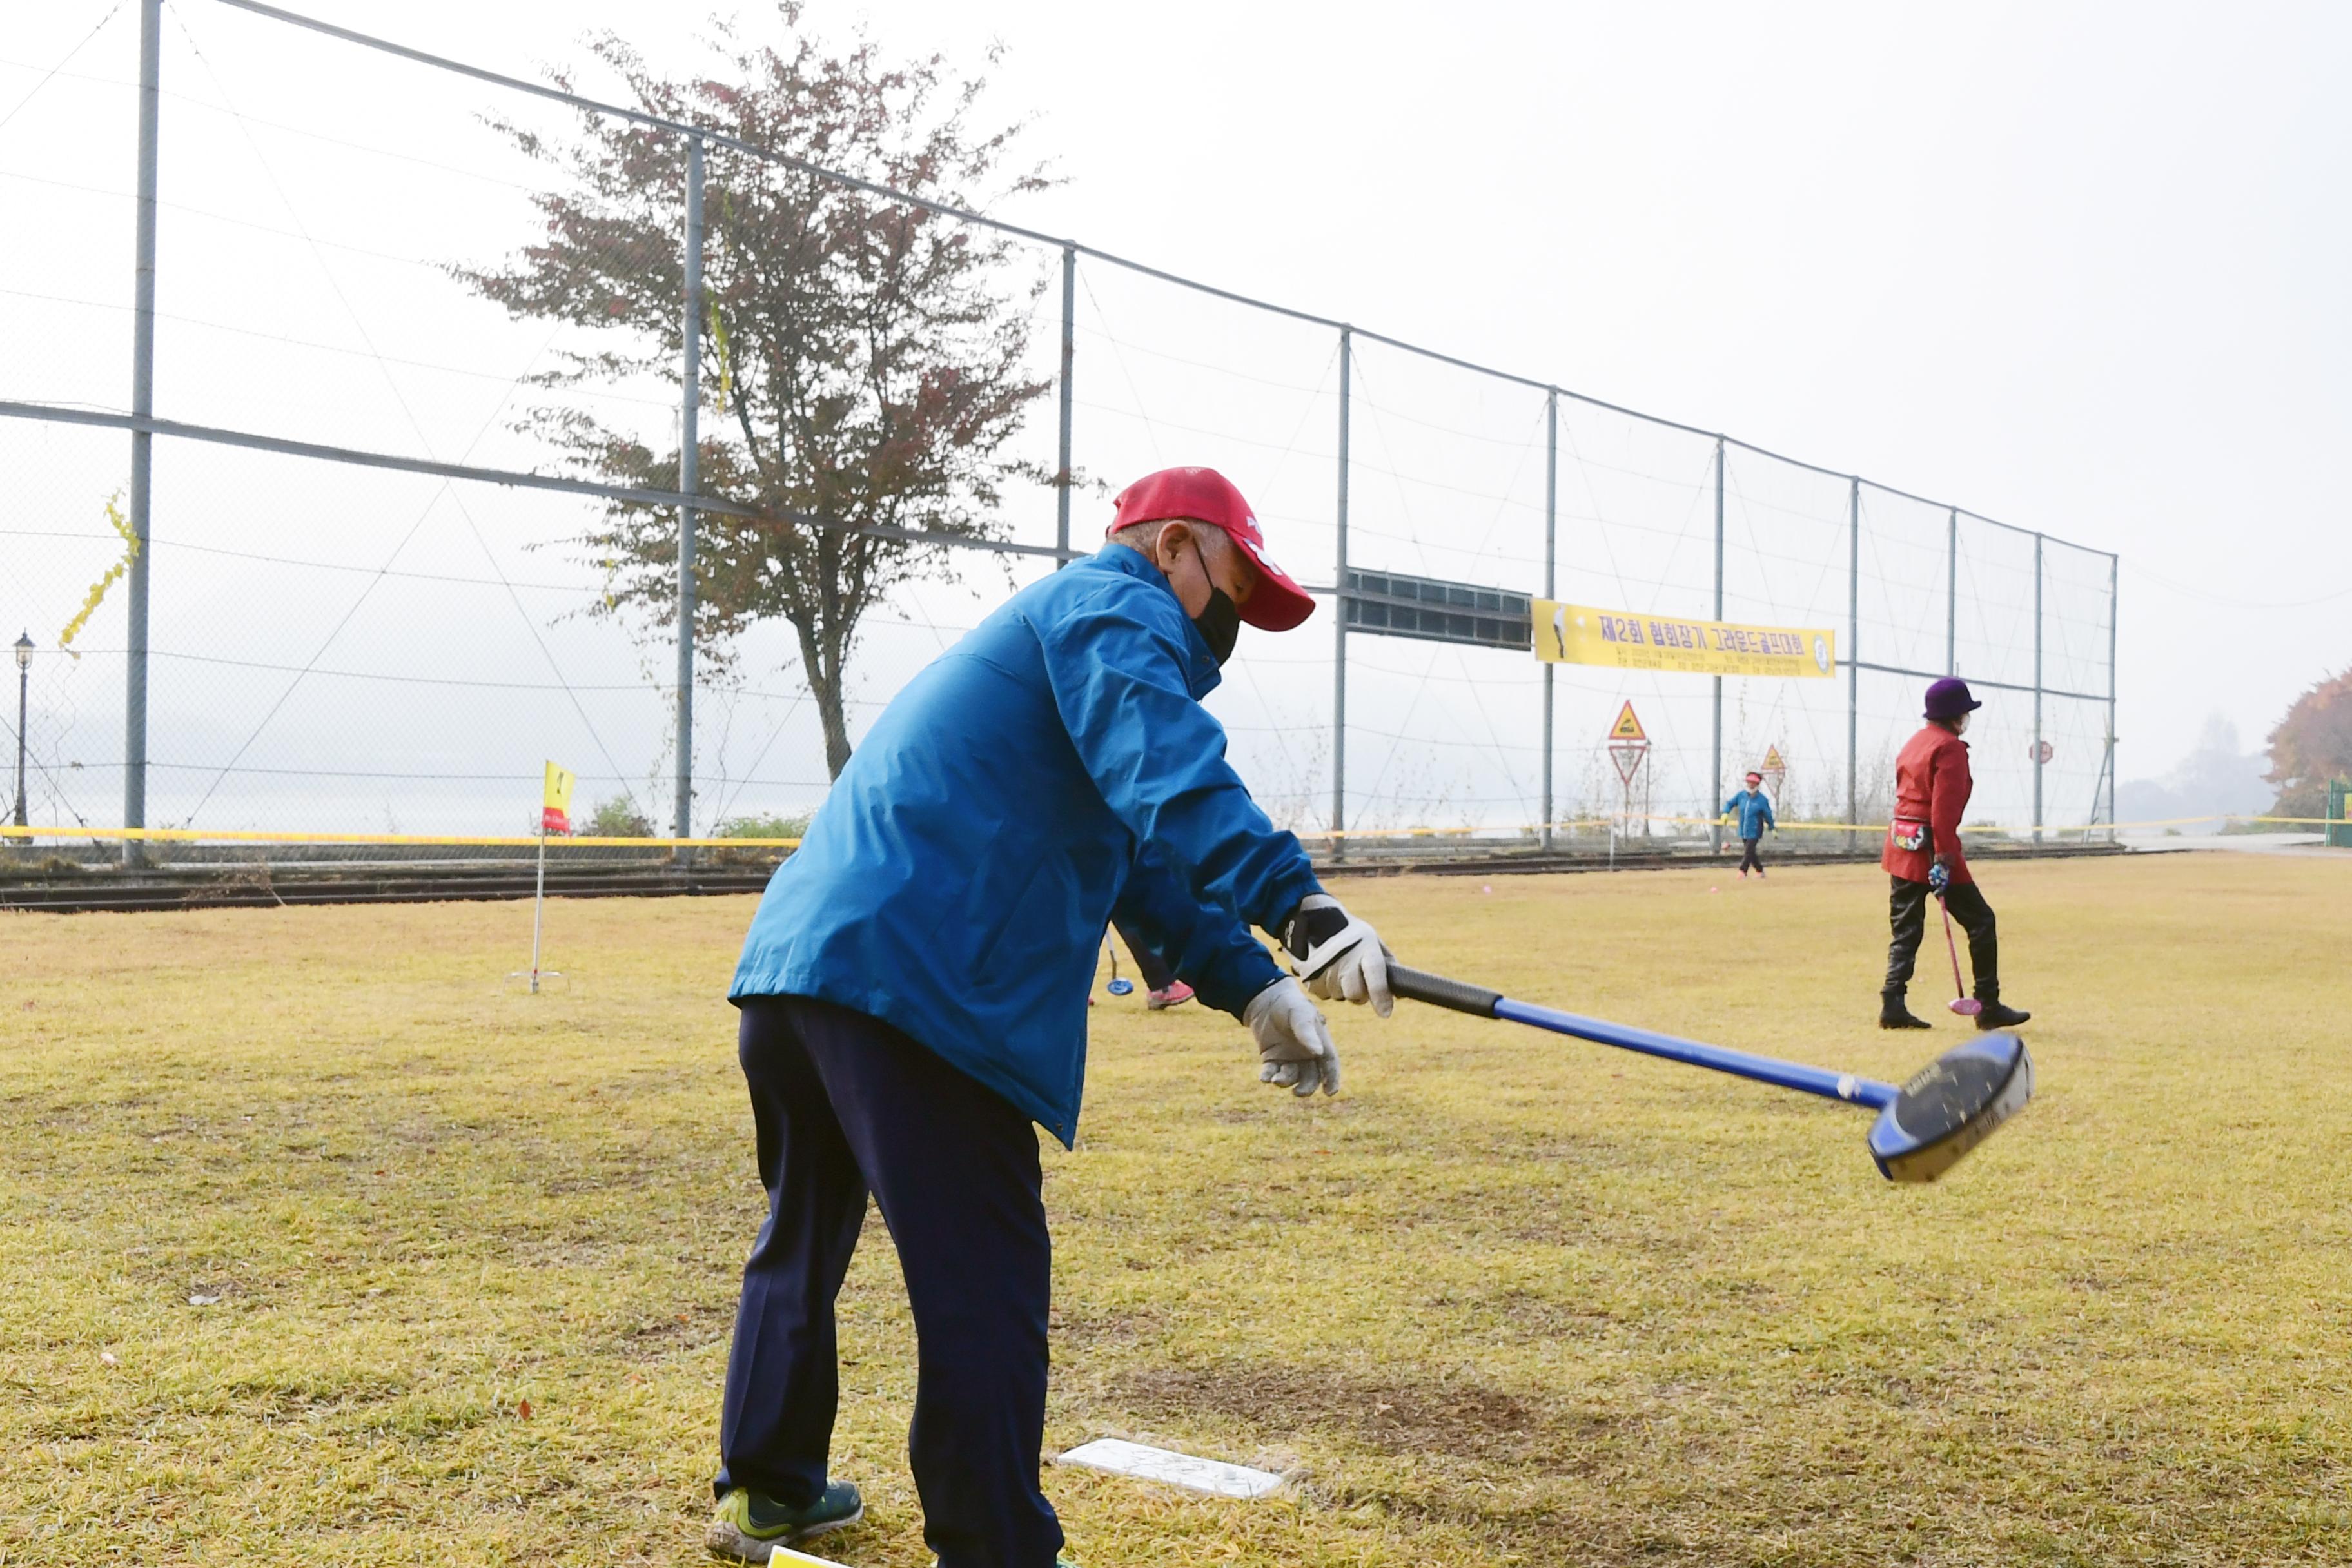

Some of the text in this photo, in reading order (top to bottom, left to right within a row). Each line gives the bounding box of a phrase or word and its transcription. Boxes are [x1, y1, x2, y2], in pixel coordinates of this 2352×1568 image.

[1599, 616, 1645, 644] 제2회
[1649, 621, 1707, 650] 협회장기
[1710, 628, 1805, 655] 그라운드골프대회
